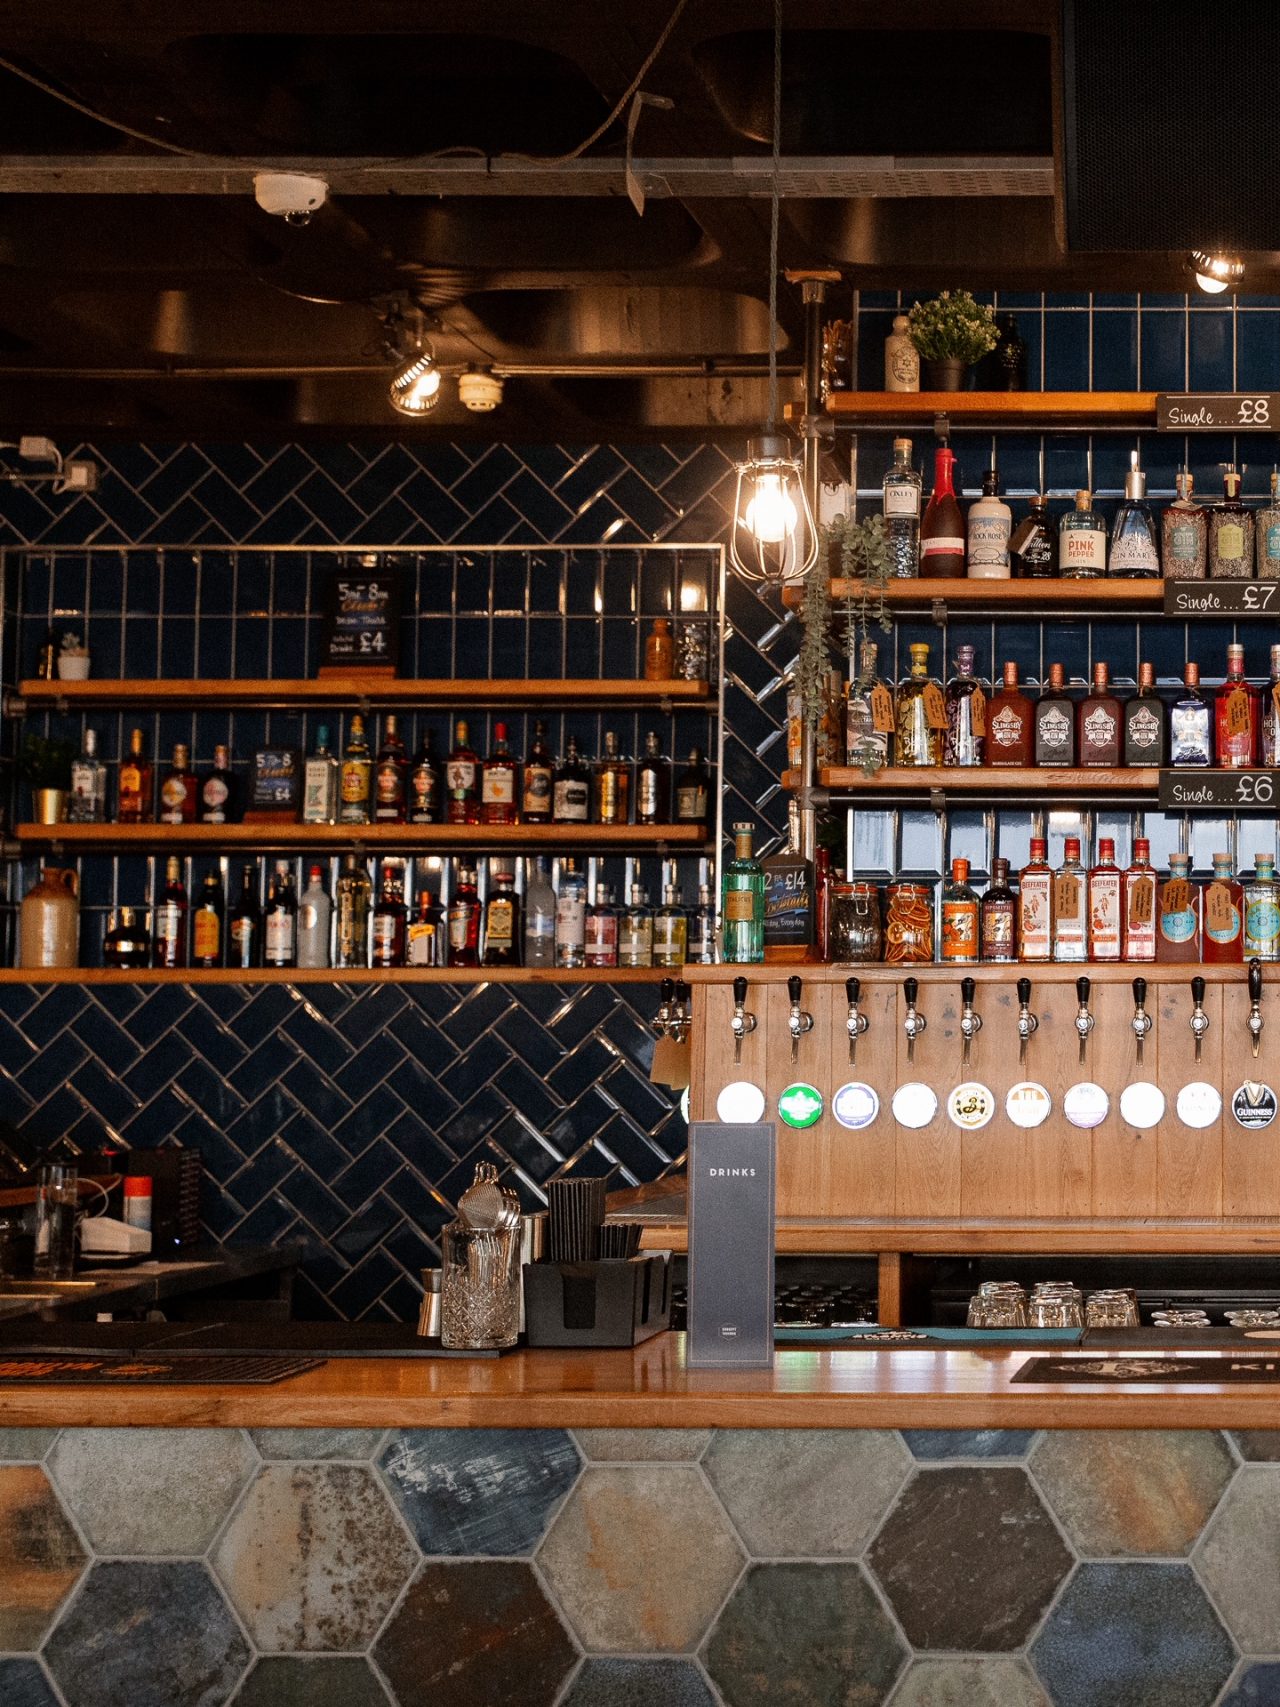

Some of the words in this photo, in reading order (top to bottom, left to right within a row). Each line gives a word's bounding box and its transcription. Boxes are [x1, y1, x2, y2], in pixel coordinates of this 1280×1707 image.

[1237, 400, 1270, 424] £8
[1068, 540, 1094, 550] PINK
[1242, 586, 1277, 610] £7
[360, 631, 387, 653] £4
[992, 720, 1023, 730] SLINGSBY
[1040, 720, 1070, 730] SLINGSBY
[1084, 720, 1116, 730] SLINGSBY
[1128, 720, 1160, 731] SLINGSBY
[1236, 776, 1273, 802] £6
[764, 872, 772, 890] 2
[785, 870, 806, 890] £14
[1021, 880, 1048, 890] BEEFEATER
[1236, 1108, 1273, 1116] GUINNESS
[709, 1168, 756, 1176] DRINKS
